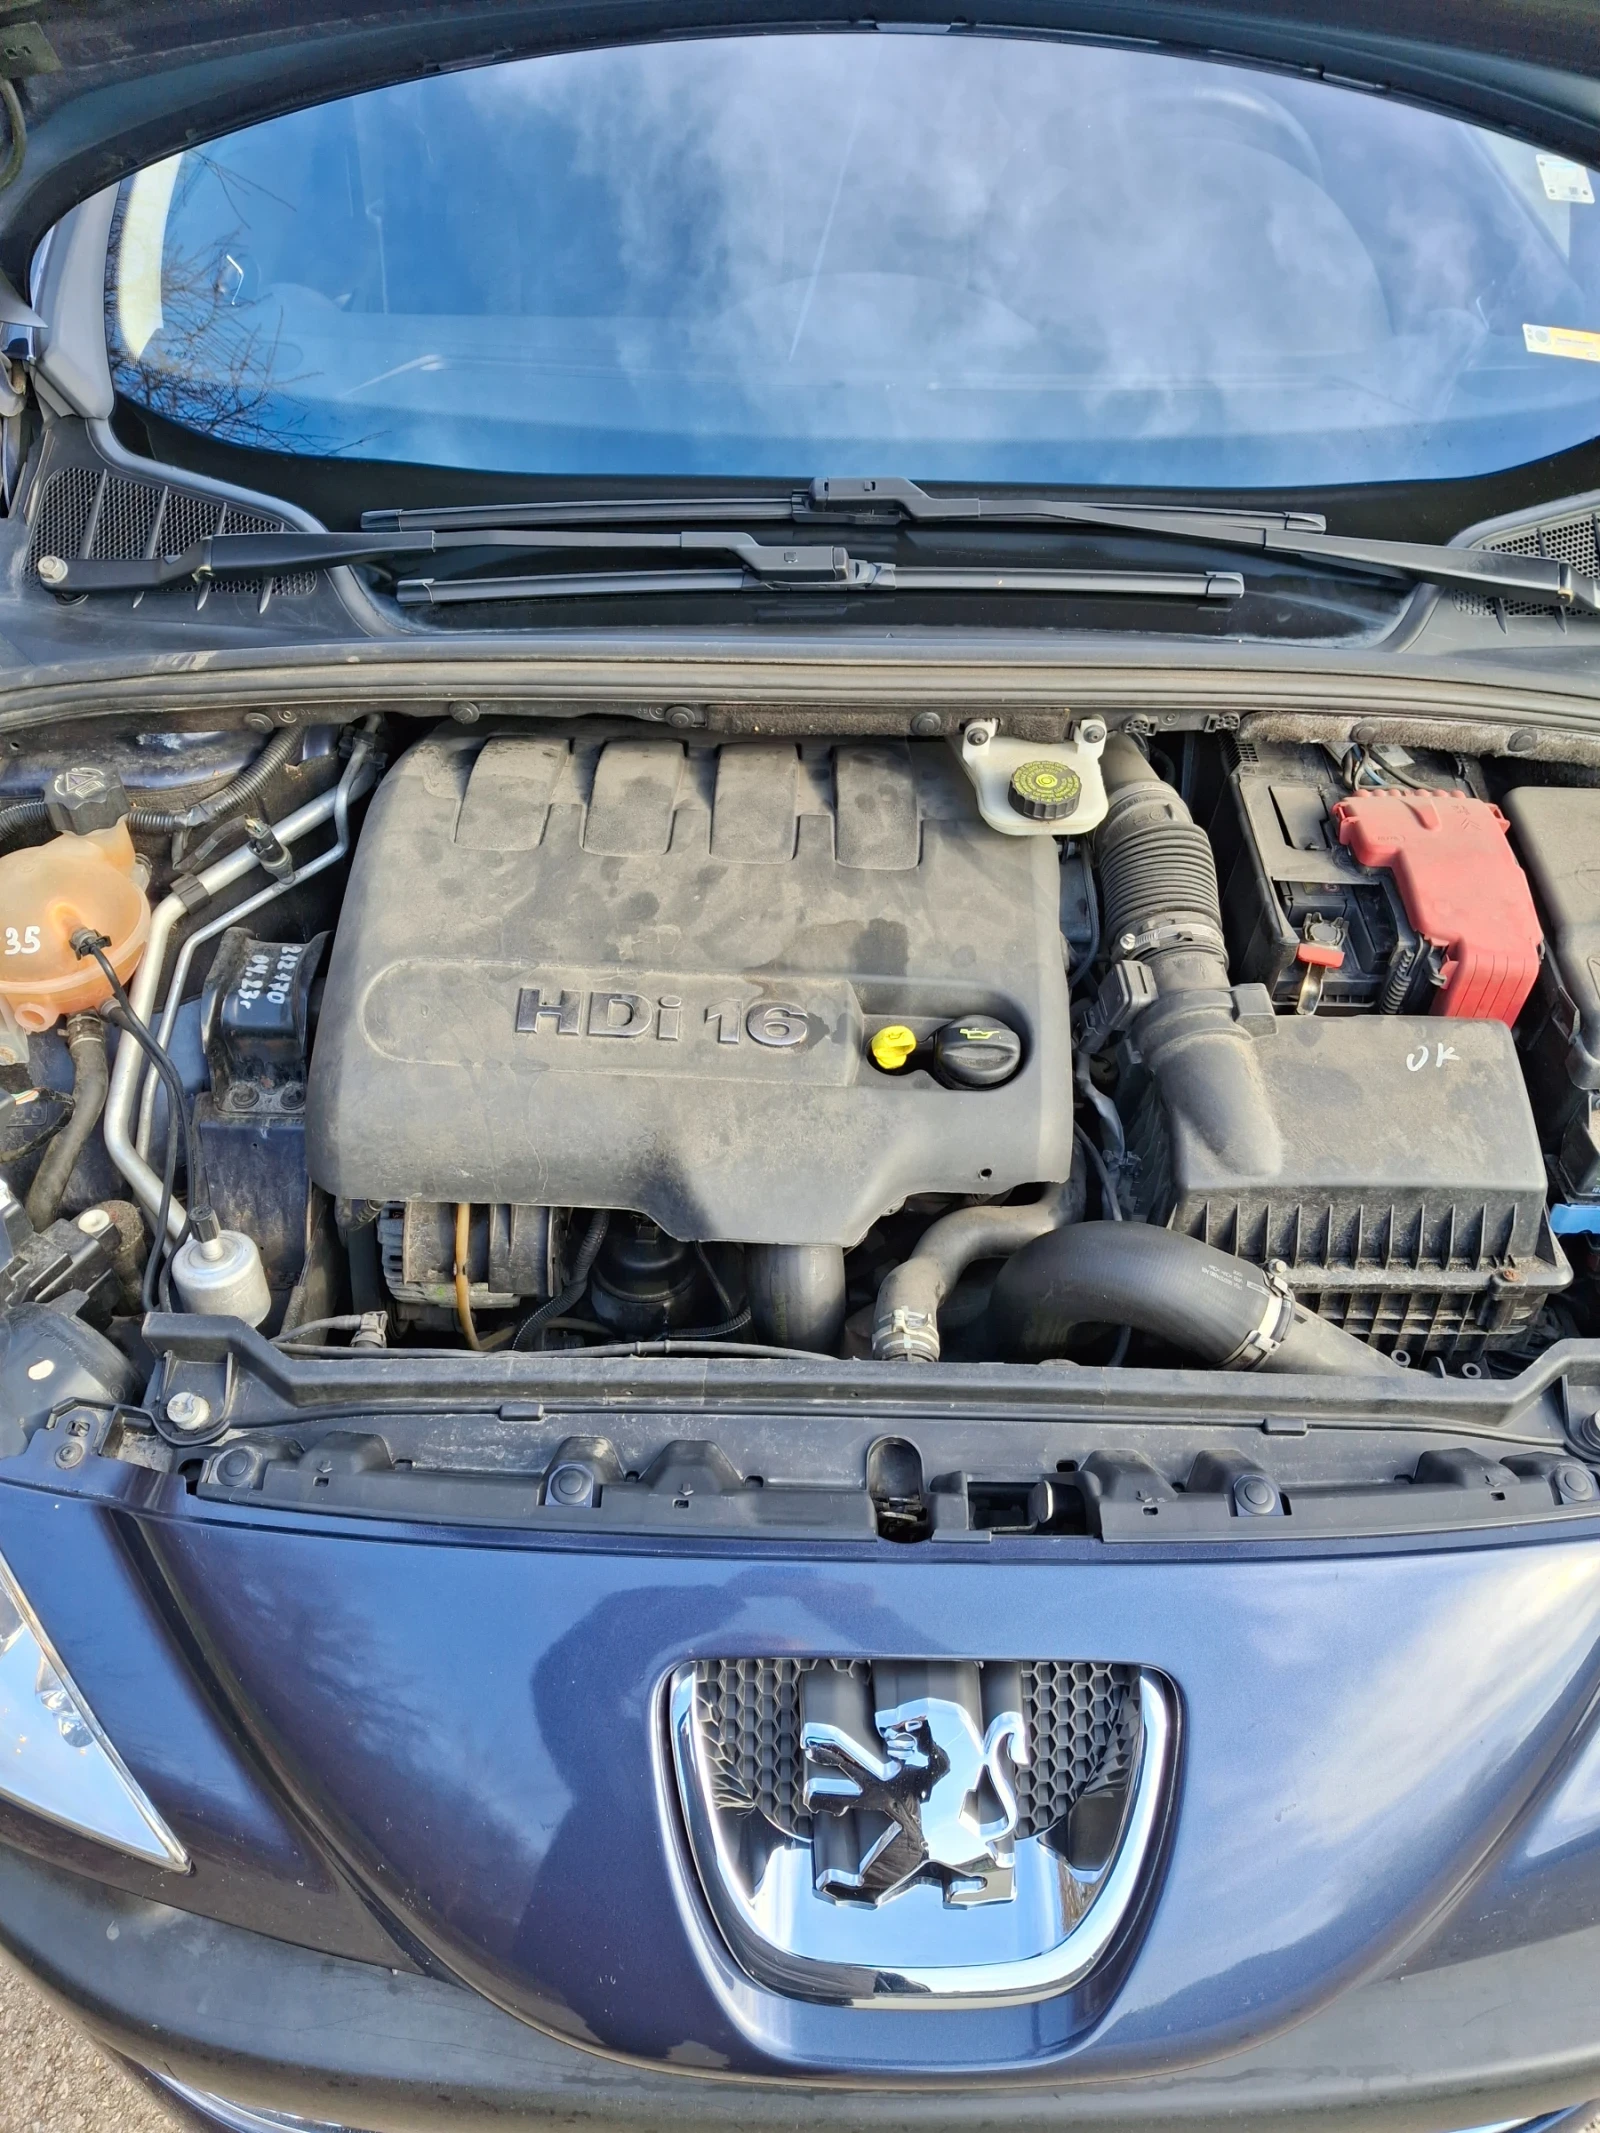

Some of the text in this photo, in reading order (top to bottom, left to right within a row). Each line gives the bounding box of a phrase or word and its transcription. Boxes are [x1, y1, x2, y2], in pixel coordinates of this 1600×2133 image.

[4, 925, 41, 955] 35
[516, 987, 809, 1047] HDi 16
[1406, 1042, 1461, 1072] OK
